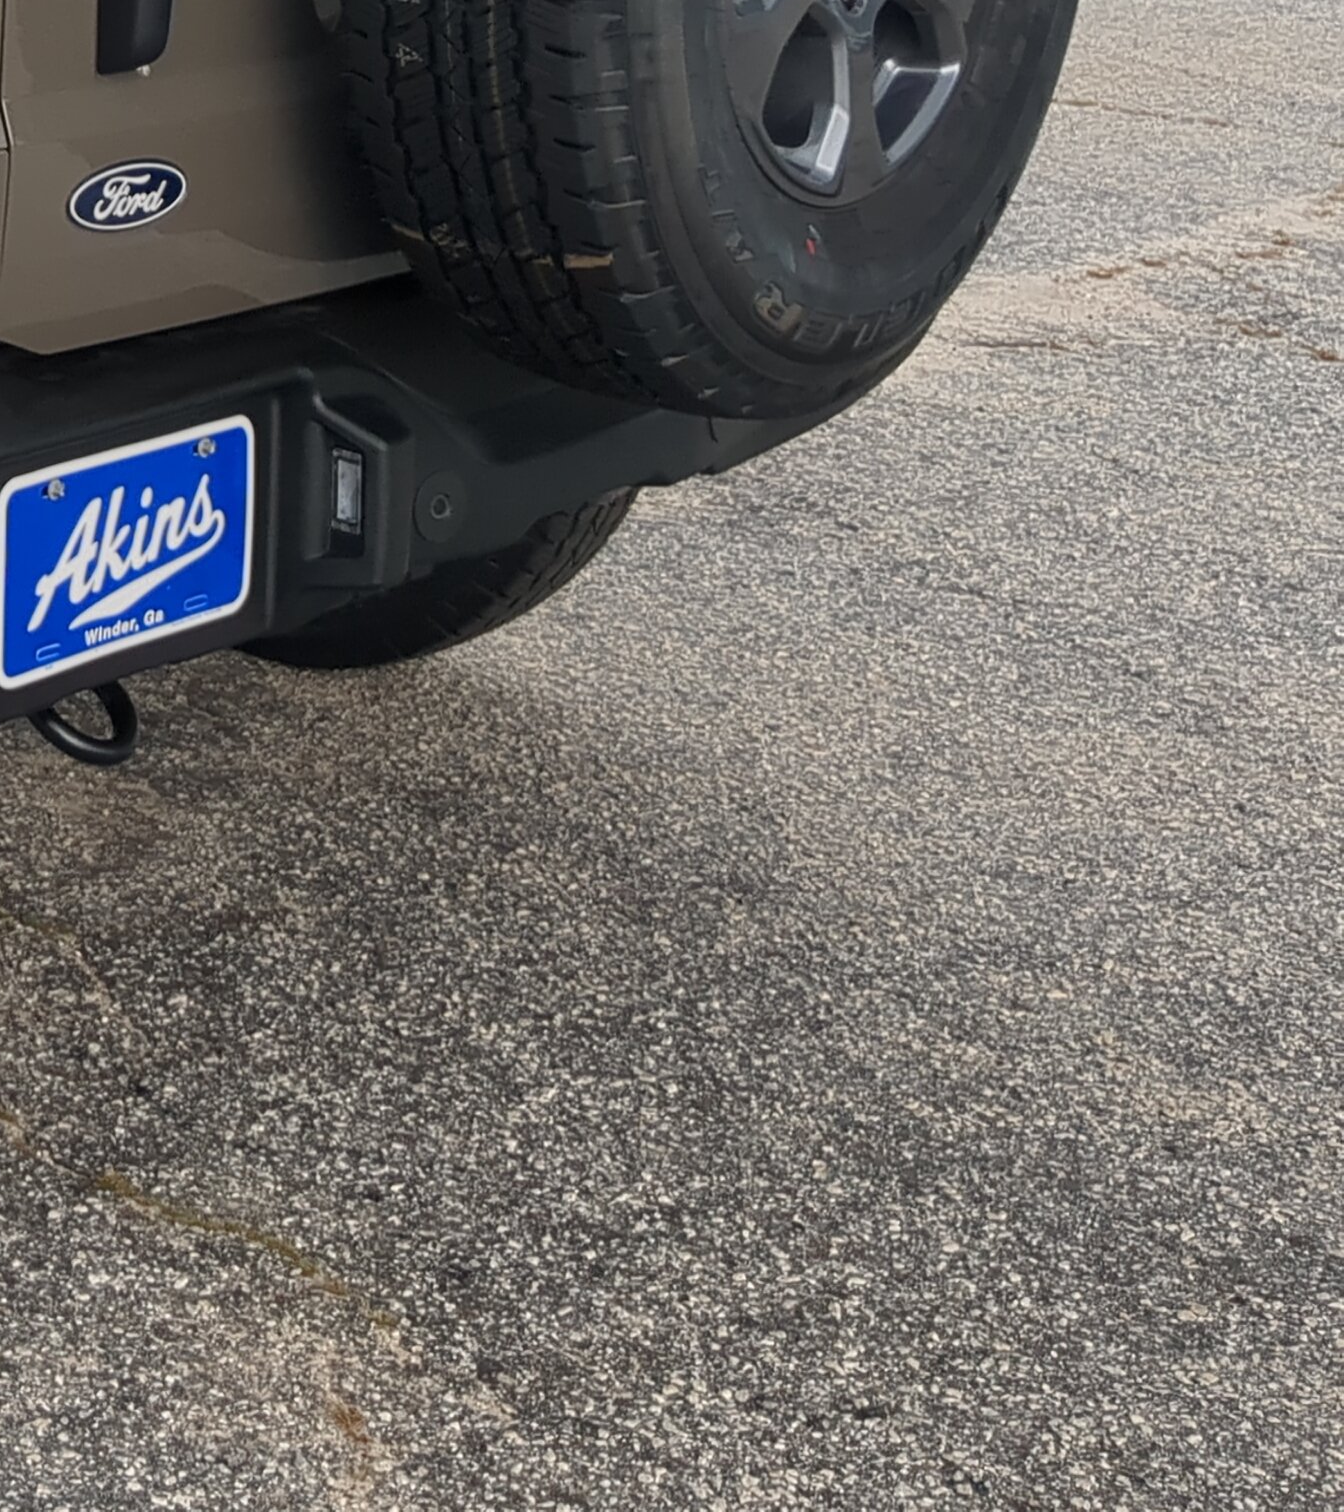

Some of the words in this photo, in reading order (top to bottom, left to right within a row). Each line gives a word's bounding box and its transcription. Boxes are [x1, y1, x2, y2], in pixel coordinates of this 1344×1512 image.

[92, 172, 167, 221] Ford
[27, 472, 226, 633] Akins
[84, 617, 140, 647] Winder,
[143, 607, 165, 627] Ga
